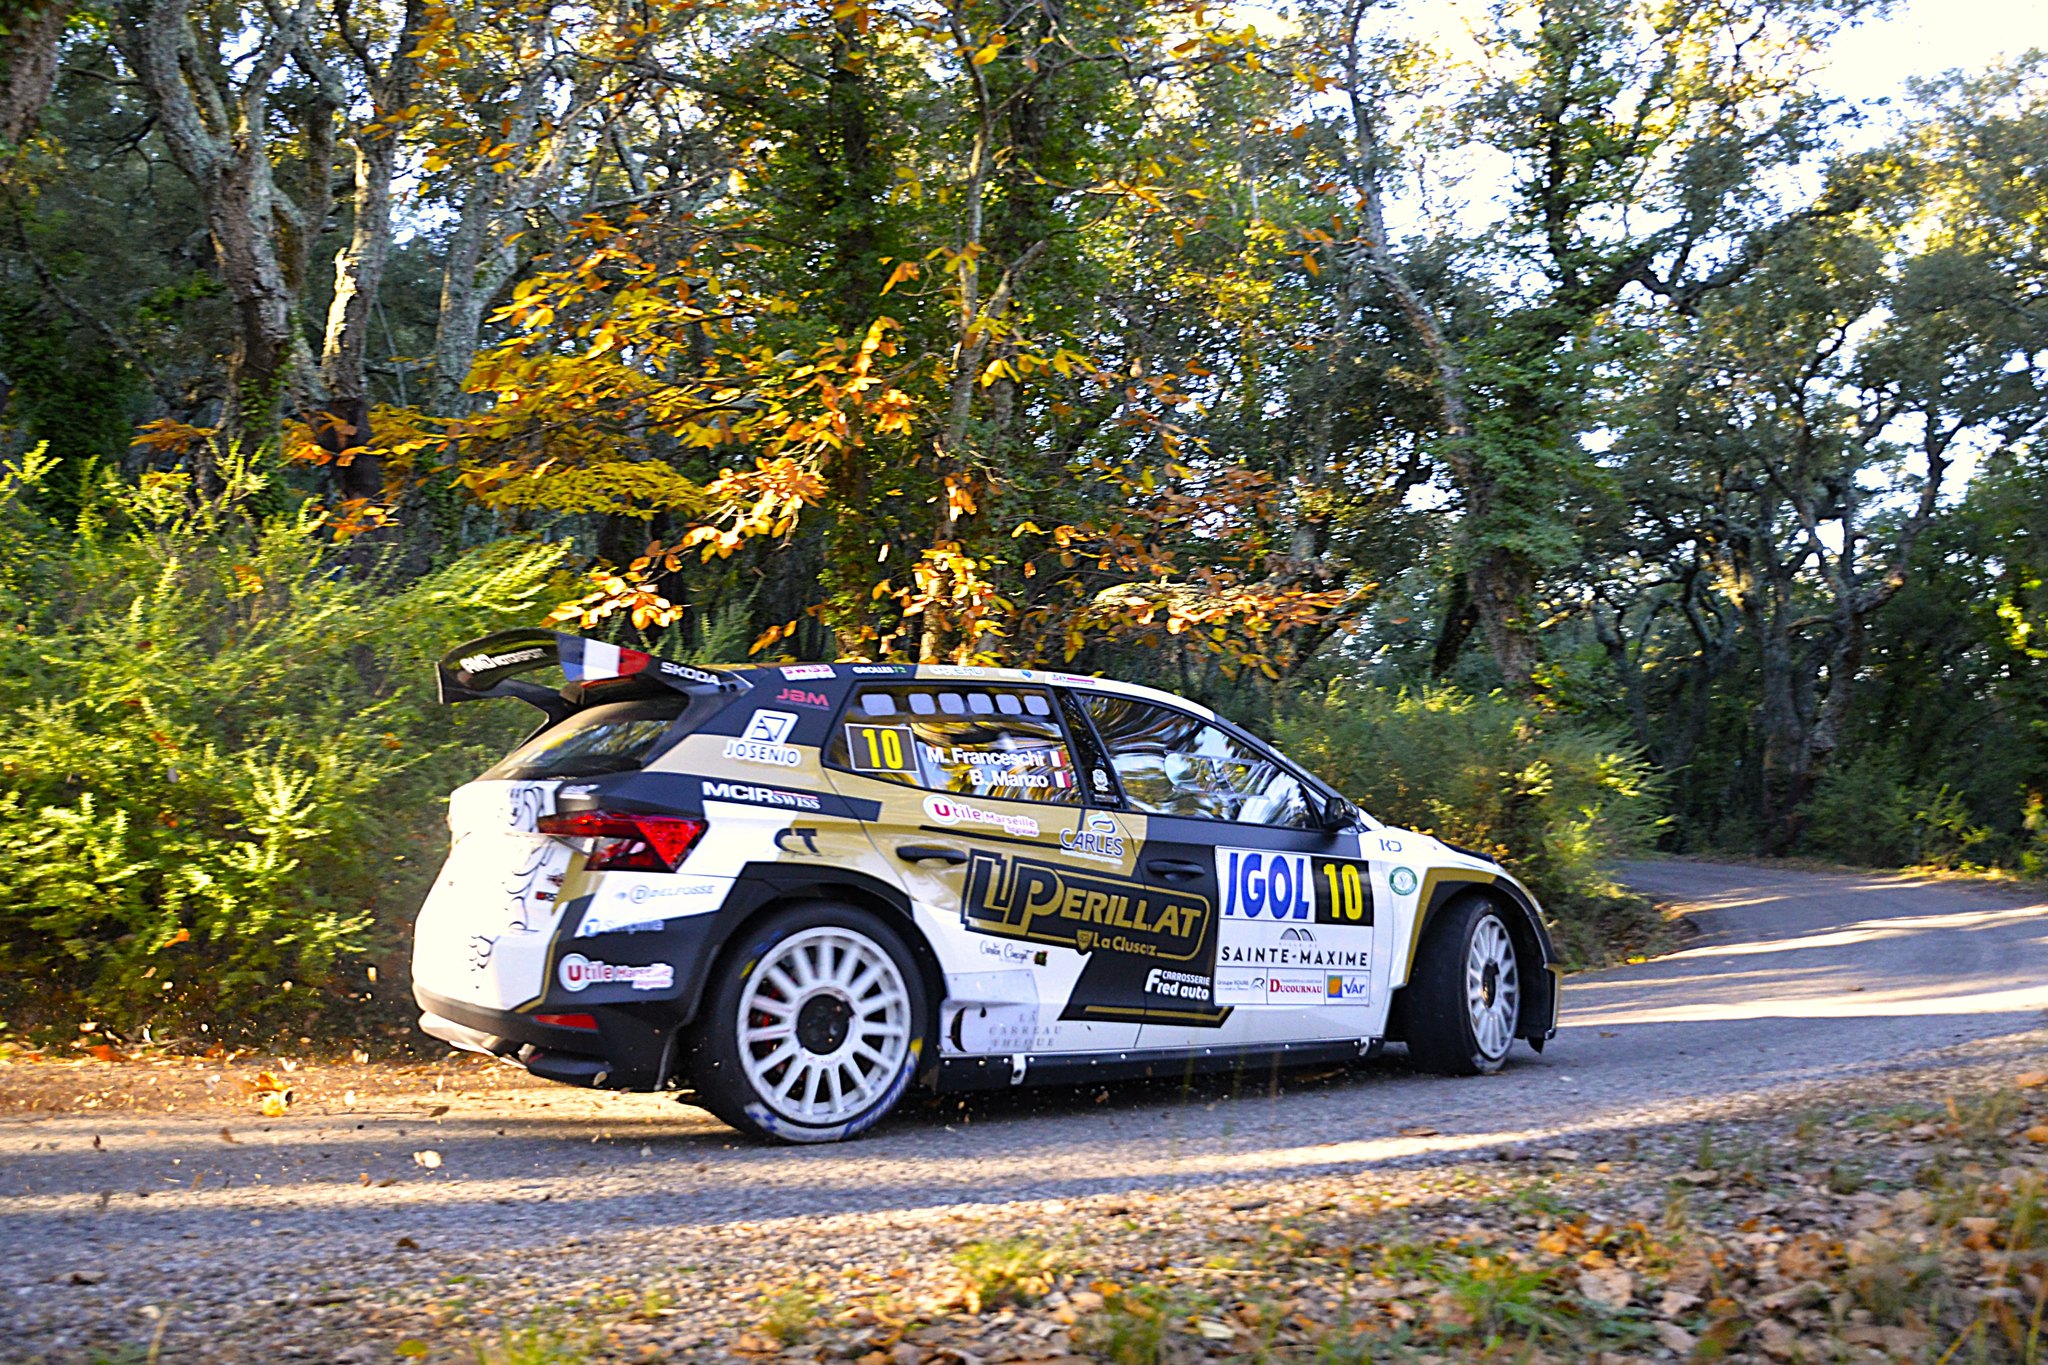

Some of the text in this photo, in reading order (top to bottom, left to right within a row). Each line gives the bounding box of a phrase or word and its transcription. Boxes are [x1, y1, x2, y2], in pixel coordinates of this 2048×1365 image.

[660, 662, 721, 685] SKODA
[775, 688, 830, 706] JBM
[726, 743, 798, 764] JOSENIO
[862, 728, 904, 769] 10
[926, 747, 1046, 767] M. Franceschi
[971, 771, 1049, 788] B. Manzo
[933, 802, 1036, 828] Utile Marseille
[1060, 829, 1124, 856] CARLES
[650, 885, 715, 897] DELFOSSE
[1225, 852, 1310, 920] IGOL
[1323, 863, 1363, 921] 10
[1093, 931, 1112, 949] La
[1221, 946, 1368, 966] SAINTE-MAXIME
[567, 964, 612, 981] Utile
[1162, 970, 1211, 986] CARROSSERIE
[1145, 968, 1210, 1000] Fred auto
[1269, 978, 1322, 993] DUCOURNAU
